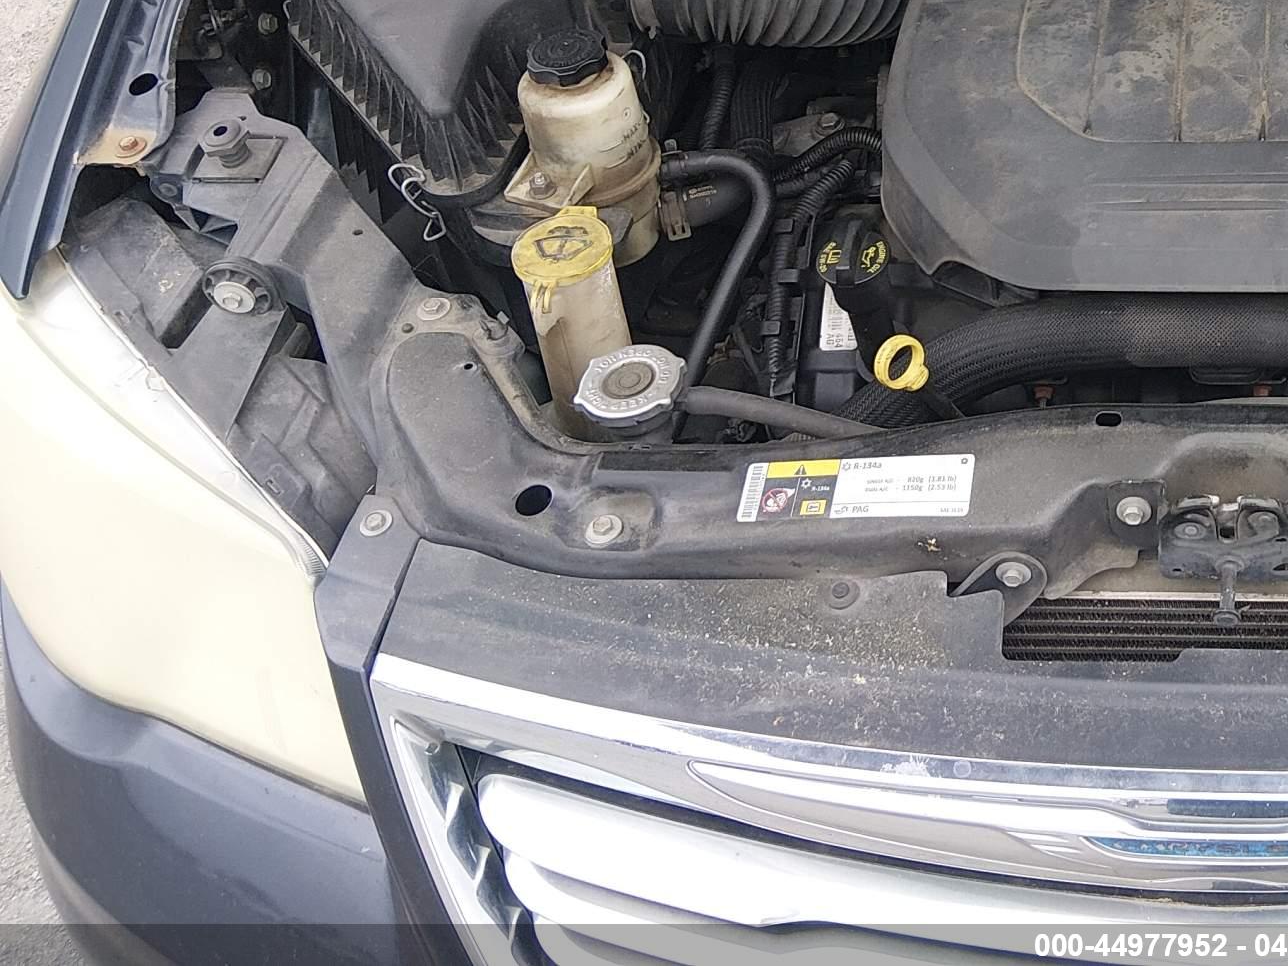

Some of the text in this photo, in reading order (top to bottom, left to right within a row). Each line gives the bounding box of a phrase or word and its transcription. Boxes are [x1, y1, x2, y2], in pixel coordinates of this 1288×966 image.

[853, 462, 883, 471] R-134a
[902, 484, 924, 493] 1150g
[851, 505, 870, 514] PAG
